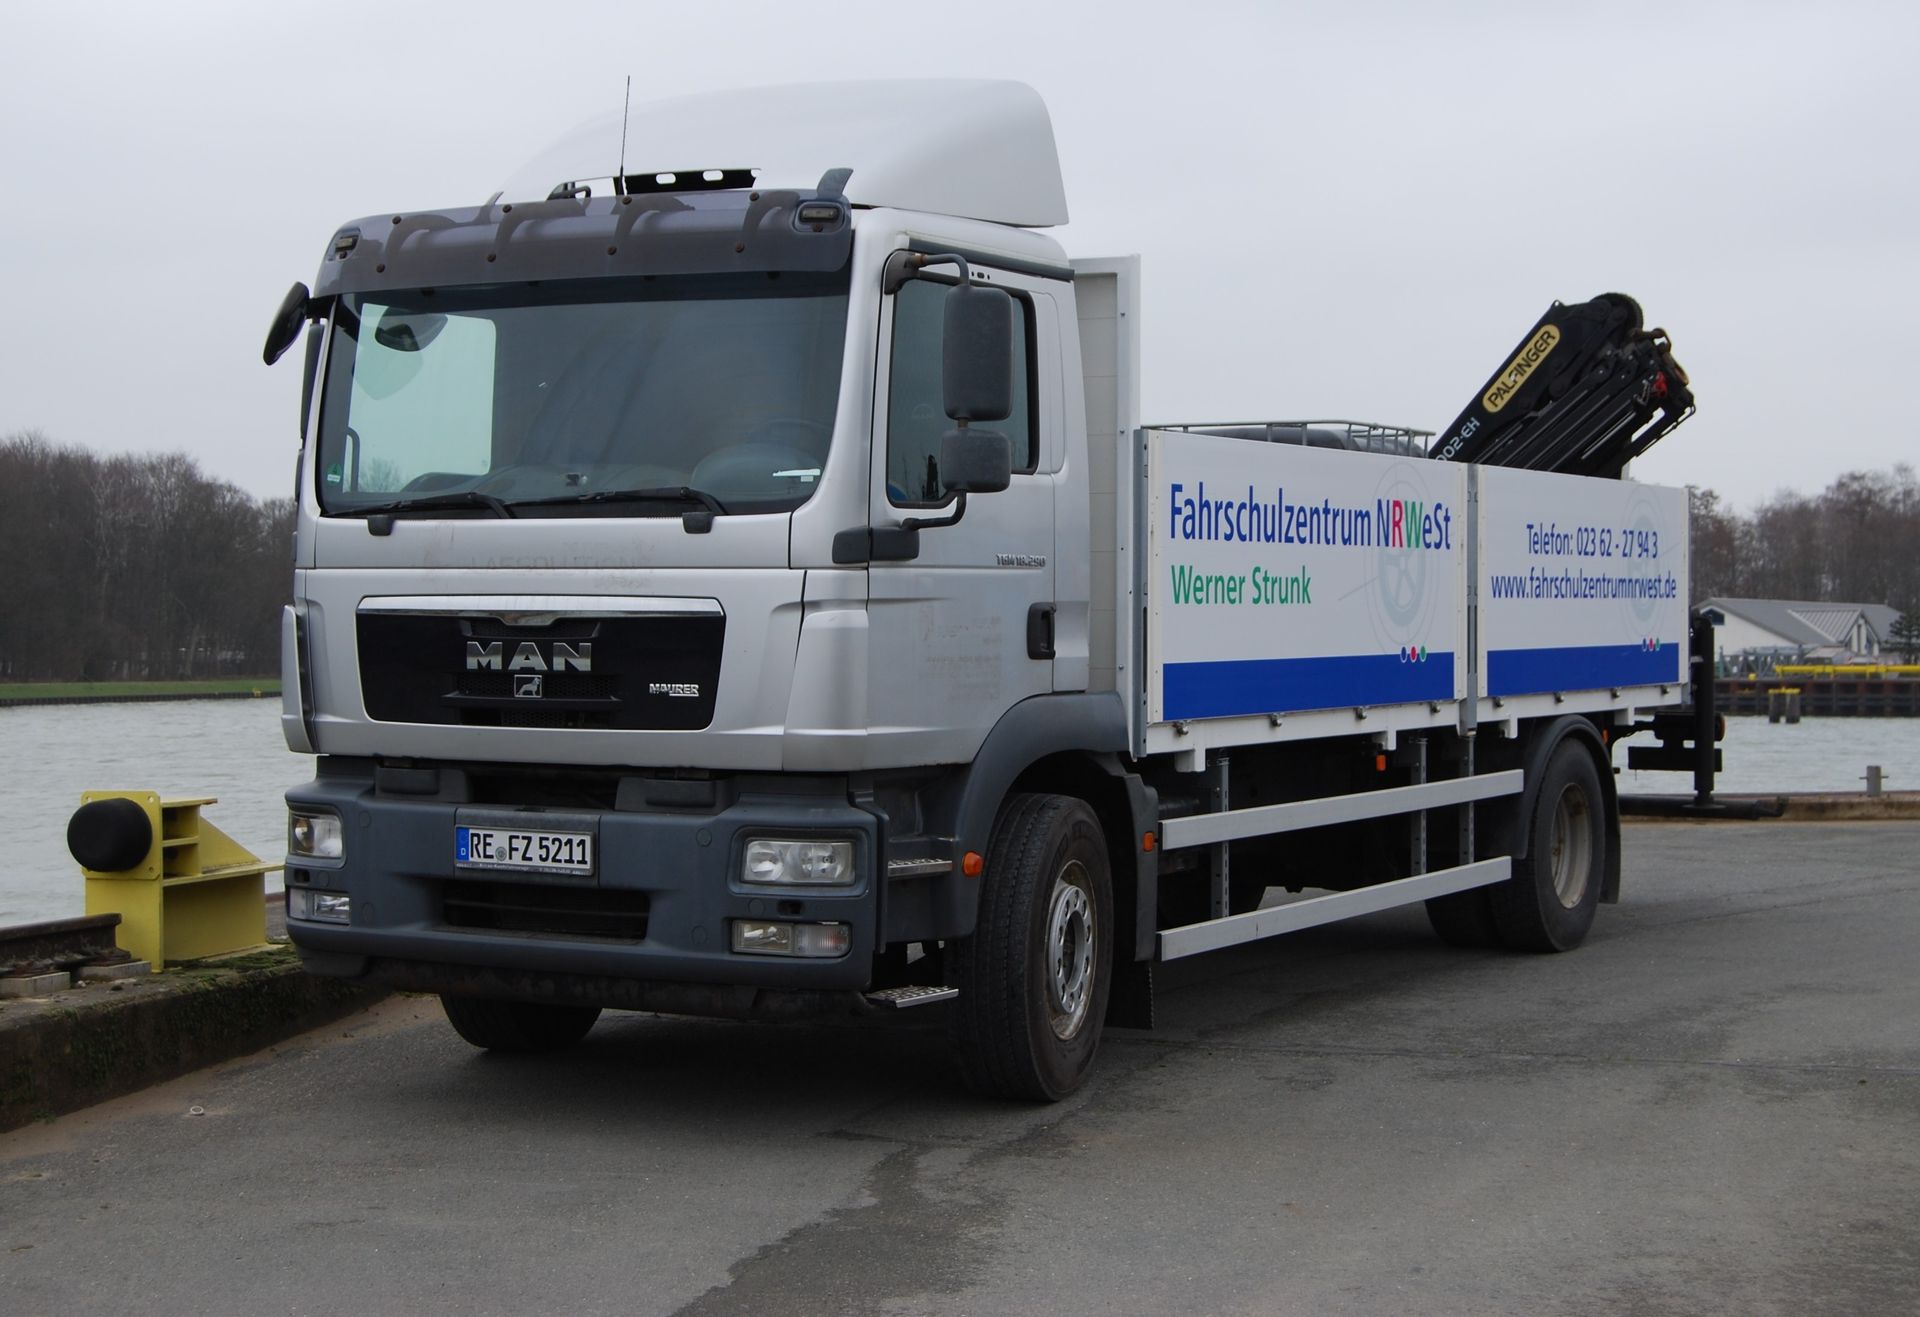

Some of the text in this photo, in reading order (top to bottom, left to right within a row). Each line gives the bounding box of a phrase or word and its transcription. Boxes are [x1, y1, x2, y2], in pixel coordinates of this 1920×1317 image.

[1487, 330, 1556, 408] PALFINGER
[1170, 481, 1451, 550] Fahrschulzentrum NRWeSt
[1526, 522, 1573, 555] Telefon:
[1170, 565, 1312, 605] Werner Strunk
[1491, 567, 1677, 599] www.fahrschulzentrumnrwest.de
[466, 641, 592, 671] MAN
[648, 683, 700, 695] MAURER
[470, 833, 494, 859] RE
[508, 835, 533, 862] FZ
[538, 836, 588, 865] 5211
